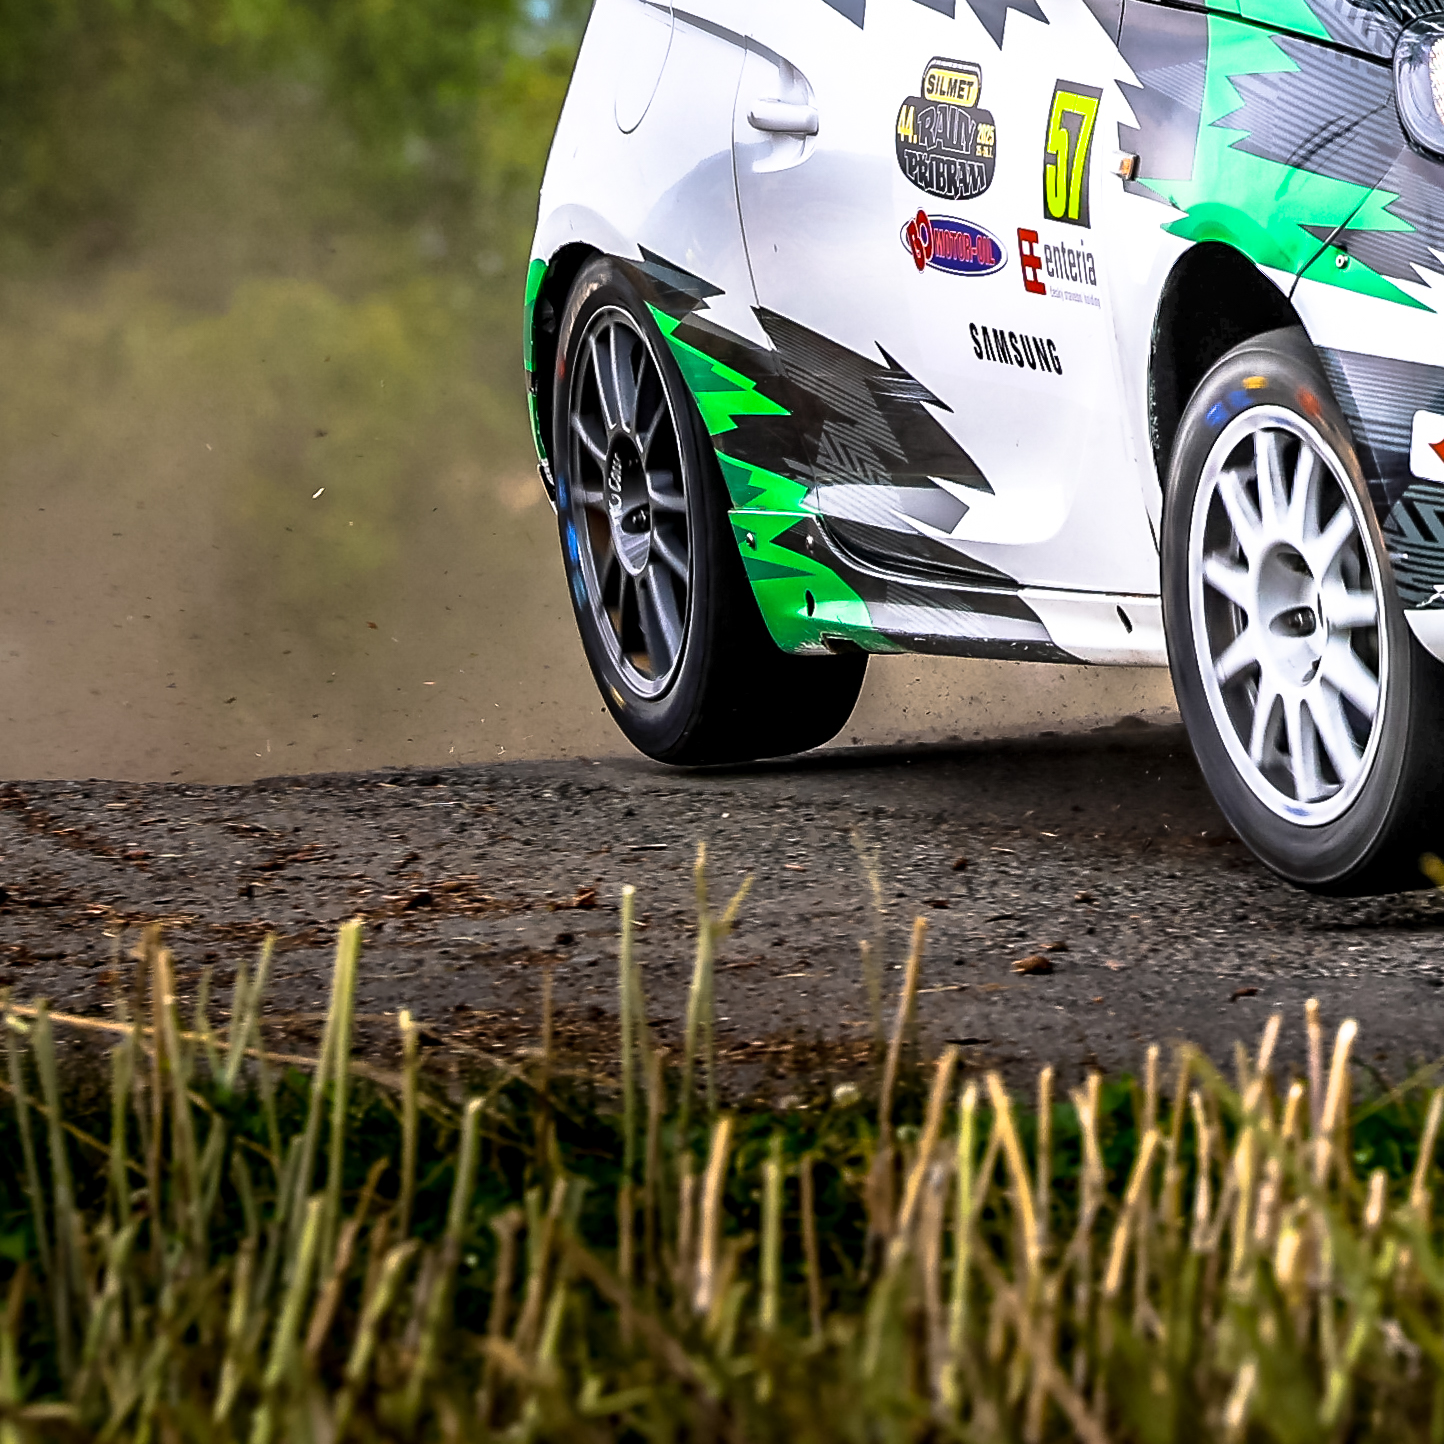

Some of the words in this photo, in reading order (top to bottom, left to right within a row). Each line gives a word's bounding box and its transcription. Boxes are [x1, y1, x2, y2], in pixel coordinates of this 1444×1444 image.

[927, 73, 974, 101] SILMET
[917, 103, 976, 154] RALLY
[1045, 91, 1101, 220] 57
[934, 227, 996, 265] MOTOR-OIL
[1044, 239, 1097, 286] enteria
[969, 323, 1063, 375] SAMSUNG
